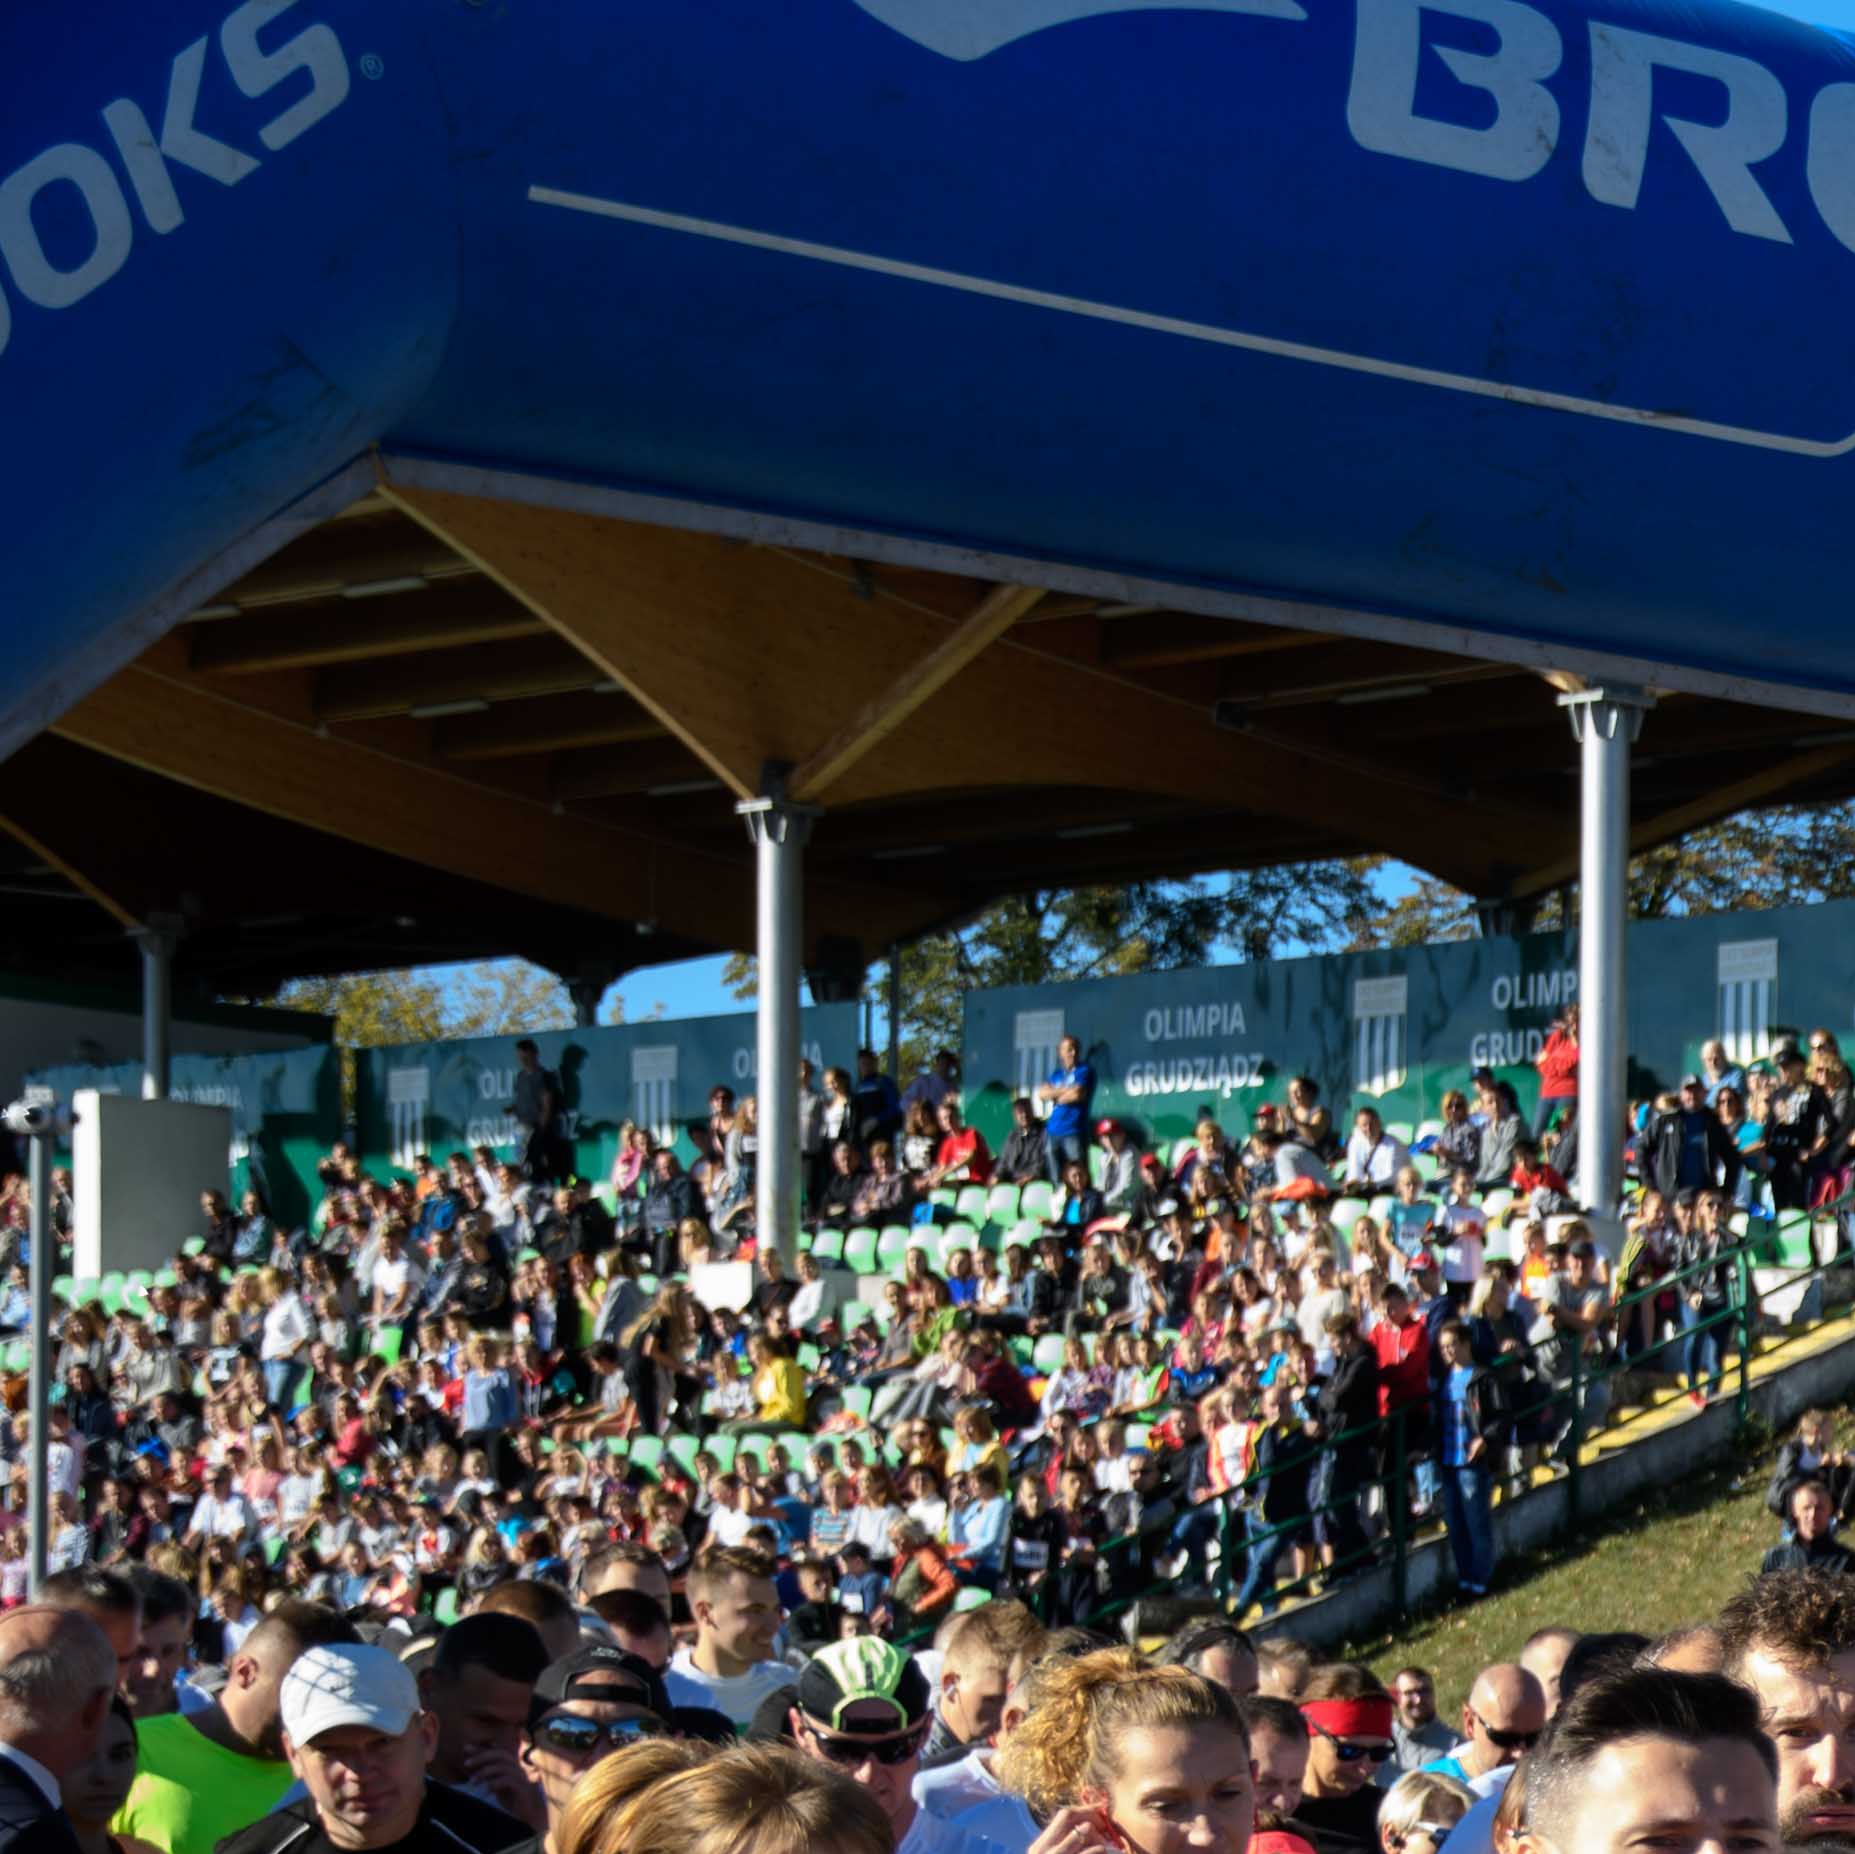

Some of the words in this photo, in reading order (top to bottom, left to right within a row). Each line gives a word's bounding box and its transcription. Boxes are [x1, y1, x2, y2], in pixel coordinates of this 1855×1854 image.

[0, 0, 351, 356] OKS
[1493, 970, 1578, 1010] OLIMP
[1145, 1003, 1247, 1042] OLIMPIA
[1124, 1053, 1265, 1099] GRUDZIĄDZ
